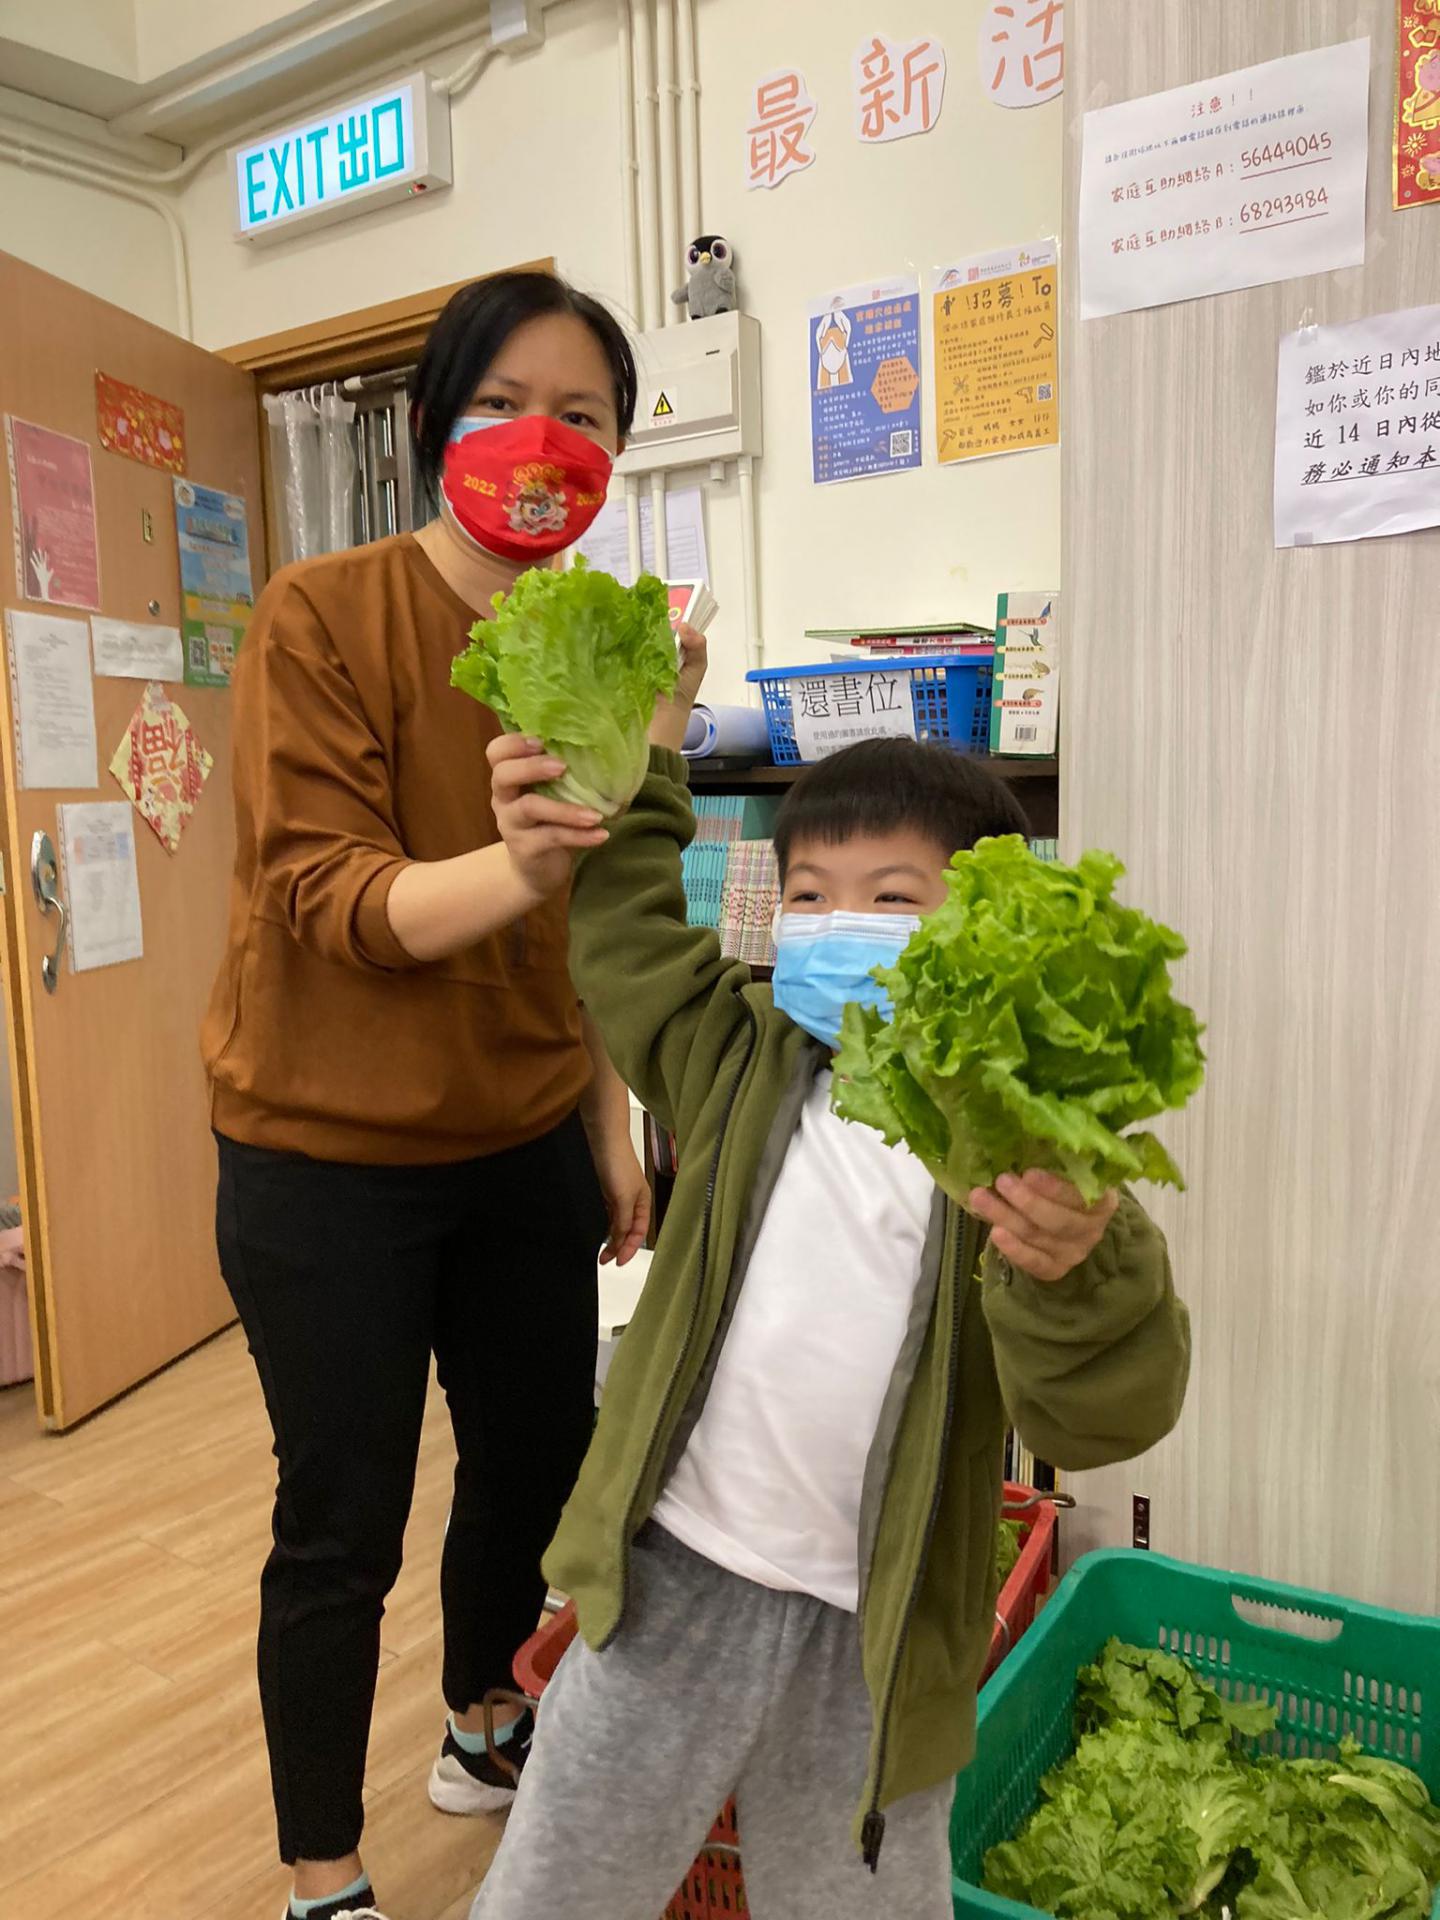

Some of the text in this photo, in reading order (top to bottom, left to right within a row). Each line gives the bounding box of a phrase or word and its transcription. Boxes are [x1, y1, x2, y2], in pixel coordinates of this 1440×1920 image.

[337, 97, 404, 192] 出口
[1241, 132, 1332, 169] 56449045
[246, 127, 328, 223] EXIT
[1240, 187, 1329, 223] 68293984
[1305, 376, 1440, 417] 如你或你的同
[1302, 445, 1437, 484] 務必通知本
[464, 474, 497, 497] 2022
[799, 673, 902, 718] 還書位
